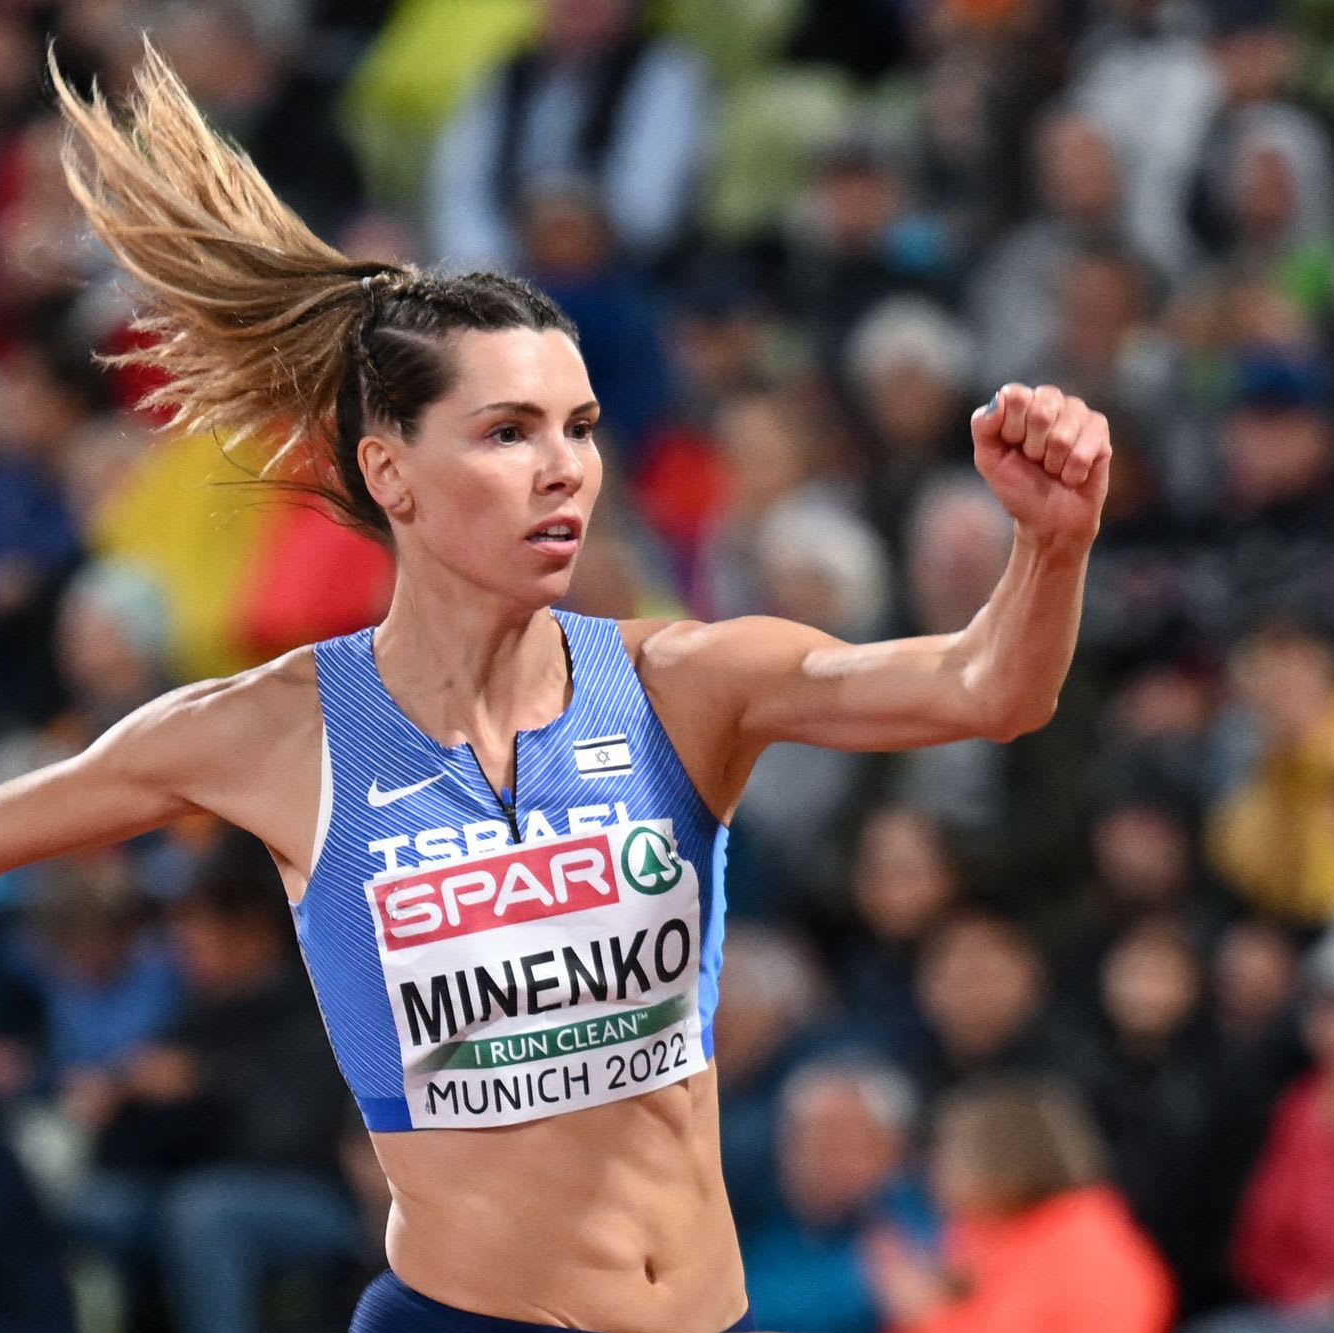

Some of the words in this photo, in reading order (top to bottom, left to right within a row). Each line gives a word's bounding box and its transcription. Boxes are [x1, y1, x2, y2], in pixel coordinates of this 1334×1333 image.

[385, 847, 611, 938] SPAR
[399, 918, 691, 1046] MINENKO
[427, 1062, 590, 1115] MUNICH
[606, 1032, 688, 1091] 2022
[474, 1044, 481, 1065] I
[491, 1034, 547, 1064] RUN
